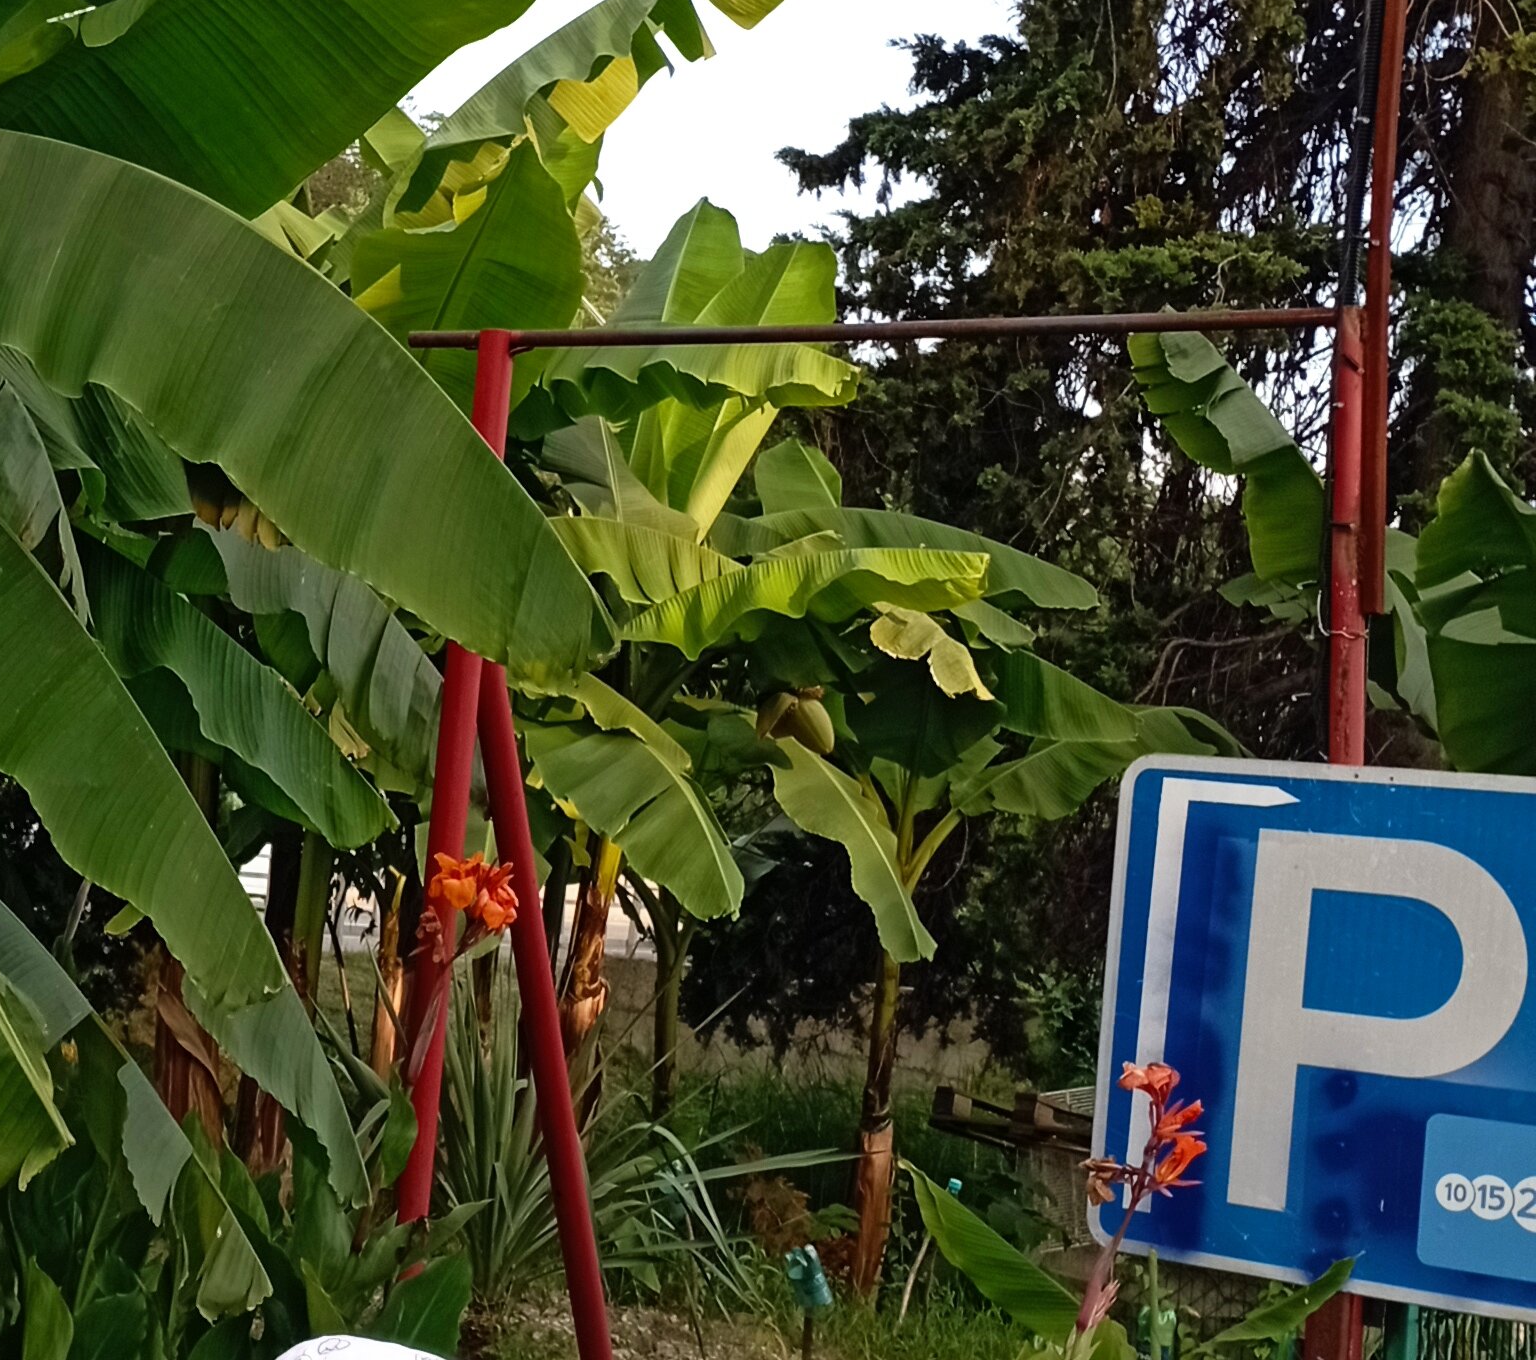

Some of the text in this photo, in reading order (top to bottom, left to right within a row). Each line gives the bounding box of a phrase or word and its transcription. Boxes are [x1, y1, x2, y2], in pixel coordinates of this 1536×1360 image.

[1227, 828, 1529, 1212] P
[1444, 1182, 1467, 1203] 10
[1477, 1184, 1505, 1211] 15
